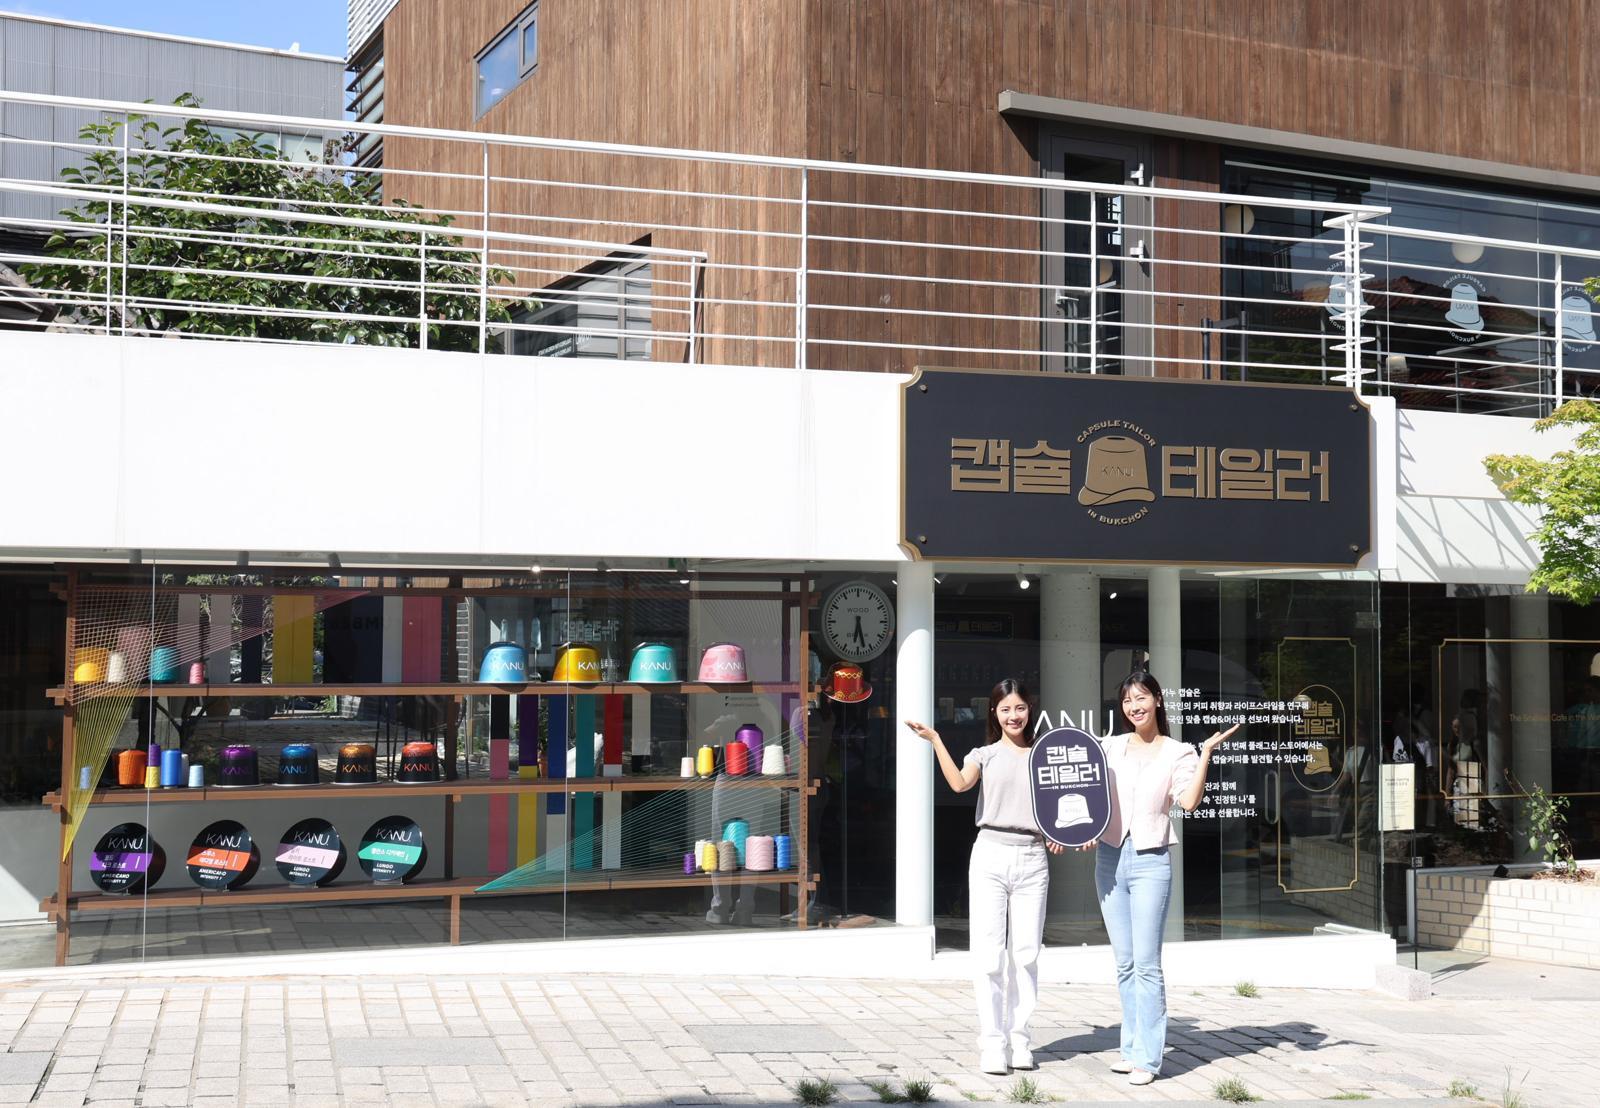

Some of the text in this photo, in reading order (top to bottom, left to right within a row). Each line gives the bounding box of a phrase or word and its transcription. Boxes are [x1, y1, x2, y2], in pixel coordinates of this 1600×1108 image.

[1077, 420, 1157, 447] CAPSULE TAILOR
[950, 437, 1331, 503] 캡슐 테일러
[1102, 465, 1134, 477] KANU
[1087, 506, 1149, 526] IN BUKCHON
[492, 661, 525, 671] KANU
[578, 661, 601, 671] KAN
[640, 661, 672, 671] KANU
[717, 661, 745, 671] KANU
[1161, 687, 1200, 697] 카누 캡슐은
[1193, 701, 1208, 711] 커피
[1210, 701, 1232, 711] 취향과
[1234, 700, 1286, 711] 라이프스타일을
[1287, 700, 1309, 711] 연구해
[1168, 714, 1304, 724] 국인 맞춤 캡슐&머신을 선보여 왔습니다.
[1033, 709, 1114, 741] ANU
[1295, 718, 1340, 735] 테일러
[1222, 741, 1230, 751] 첫
[1232, 741, 1247, 751] 번째
[1248, 741, 1278, 750] 플래그십
[1279, 740, 1324, 750] 스토어에서는
[1046, 744, 1089, 765] 캡슐
[1212, 754, 1249, 764] 캡슐커피를
[1251, 754, 1273, 764] 발견할
[1275, 754, 1282, 764] 수
[1284, 754, 1316, 764] 있습니다.
[403, 763, 433, 772] KANU
[1037, 762, 1101, 785] 테일러
[1221, 781, 1237, 791] 함께
[1203, 794, 1256, 805] 속 '진정한 나'를
[1168, 808, 1257, 819] 이하는 순간을 선물합니다.
[206, 833, 242, 848] KANU
[294, 831, 330, 846] KANU
[376, 828, 413, 842] KANU
[108, 837, 144, 850] KANU
